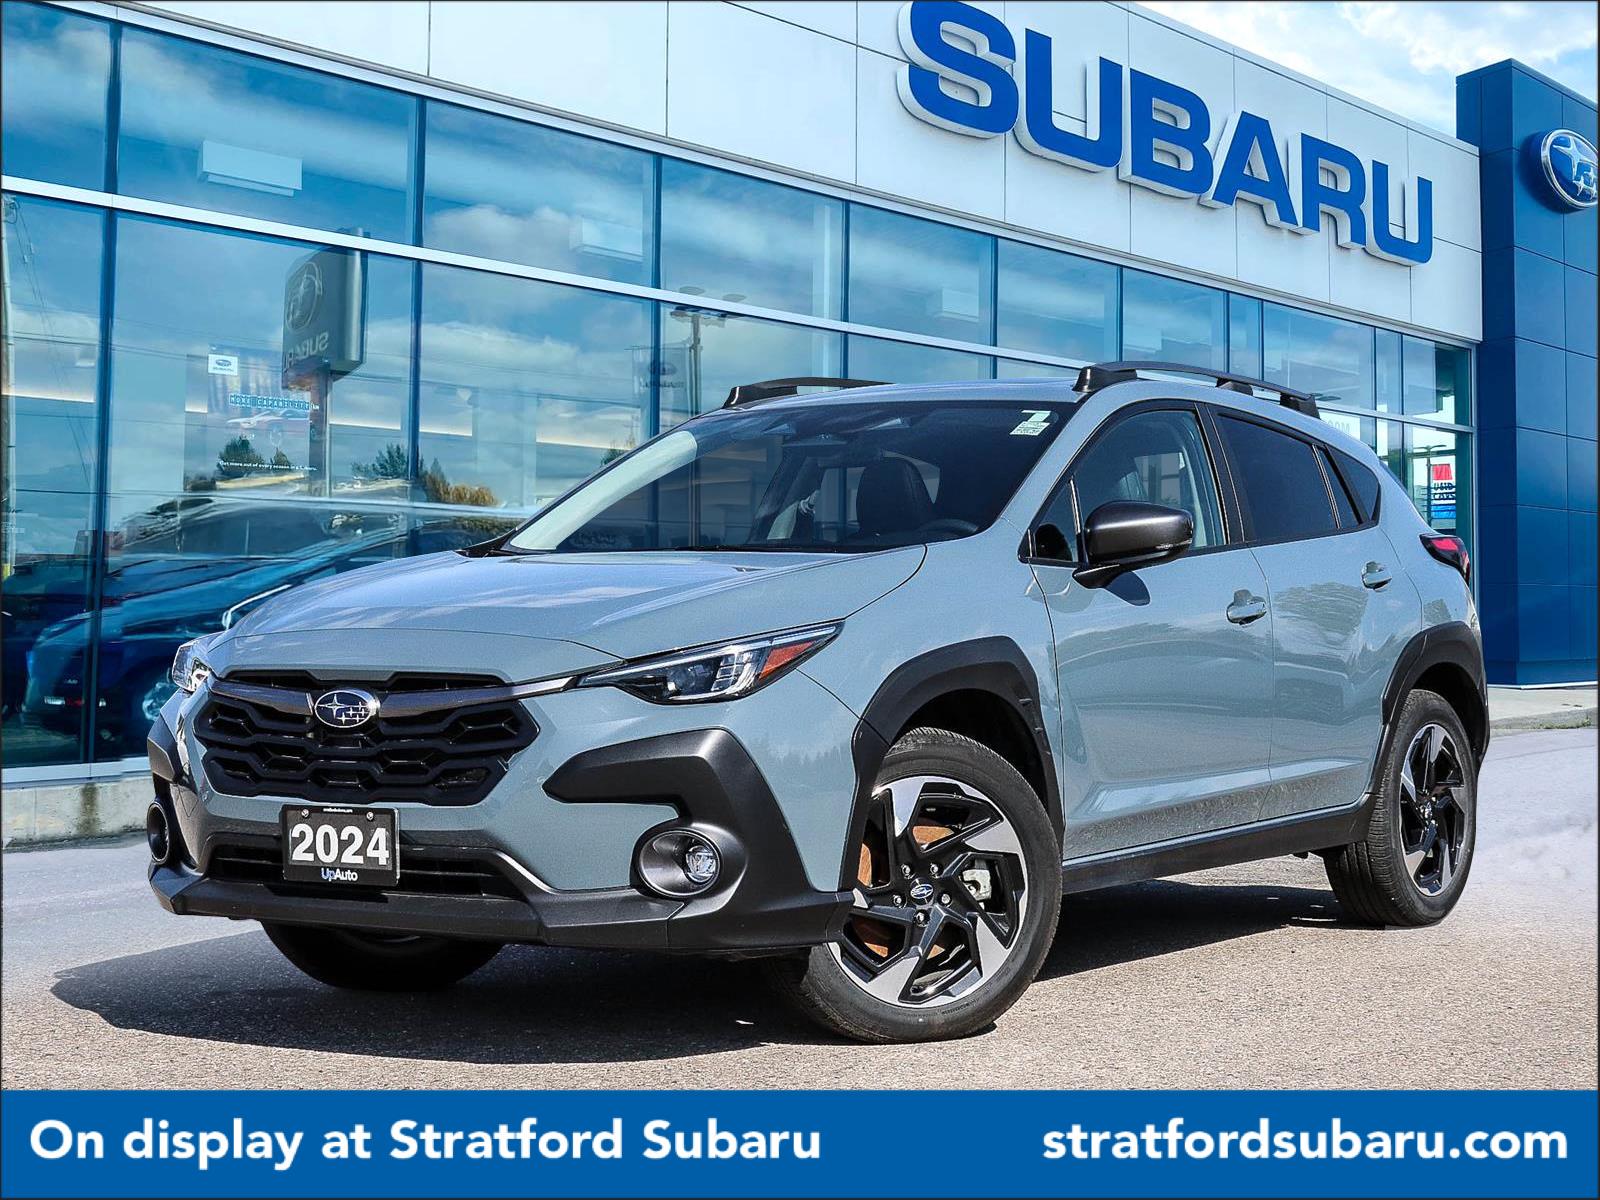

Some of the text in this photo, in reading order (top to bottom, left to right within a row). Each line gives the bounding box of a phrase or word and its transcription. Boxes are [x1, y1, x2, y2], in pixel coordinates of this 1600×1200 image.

[903, 1, 1433, 265] SUBARU
[291, 823, 390, 866] 2024
[321, 867, 359, 882] UpAuto
